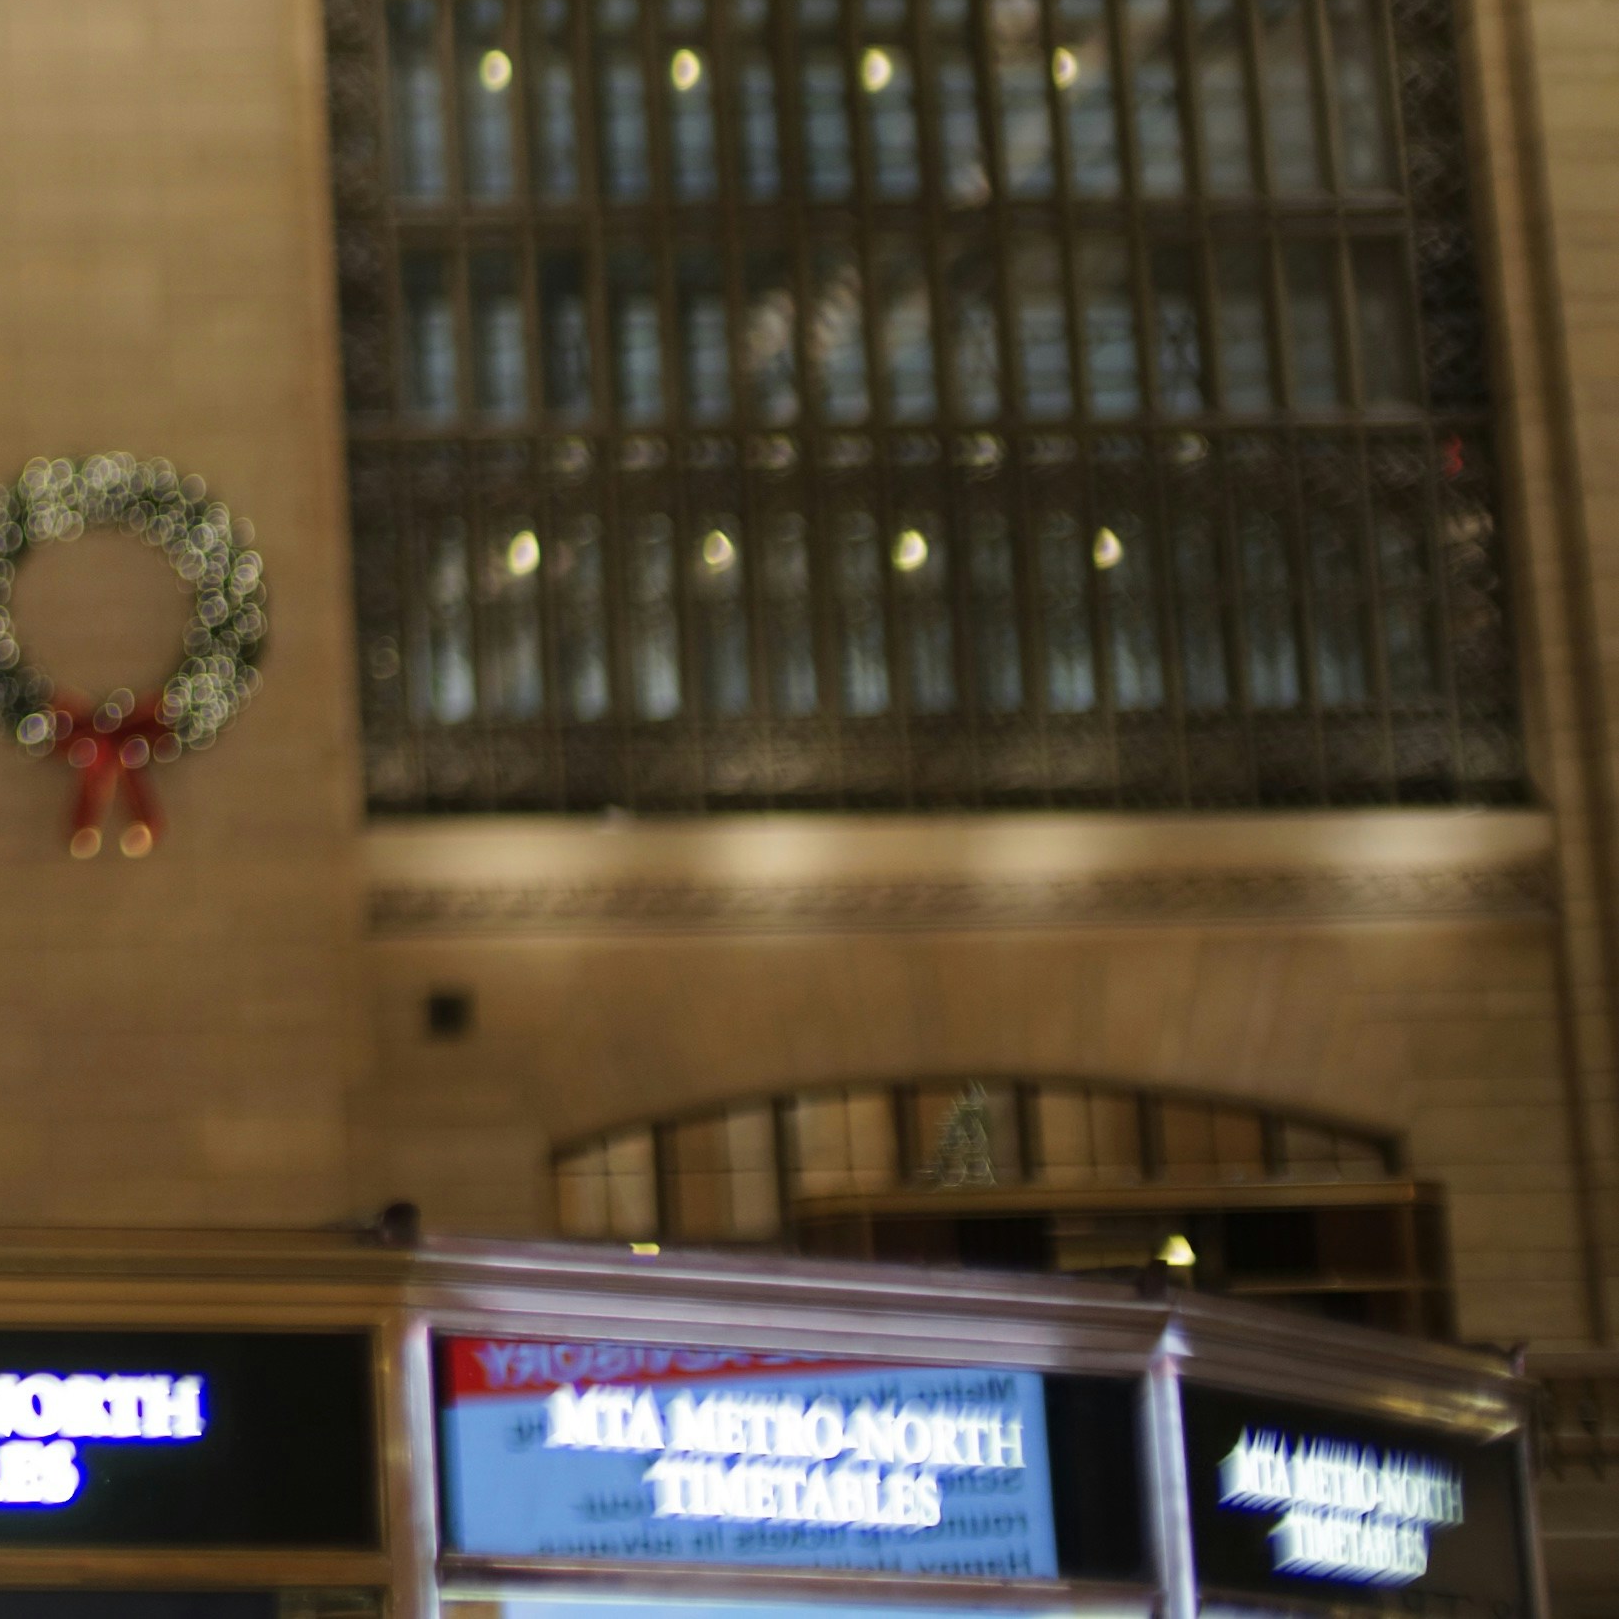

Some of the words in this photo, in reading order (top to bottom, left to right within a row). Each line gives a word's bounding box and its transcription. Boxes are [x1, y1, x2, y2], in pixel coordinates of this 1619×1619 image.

[543, 1384, 666, 1451] MTA
[664, 1387, 1026, 1469] METRO-NORTH
[644, 1455, 943, 1528] TIMETABLES
[1218, 1437, 1292, 1509] MTA
